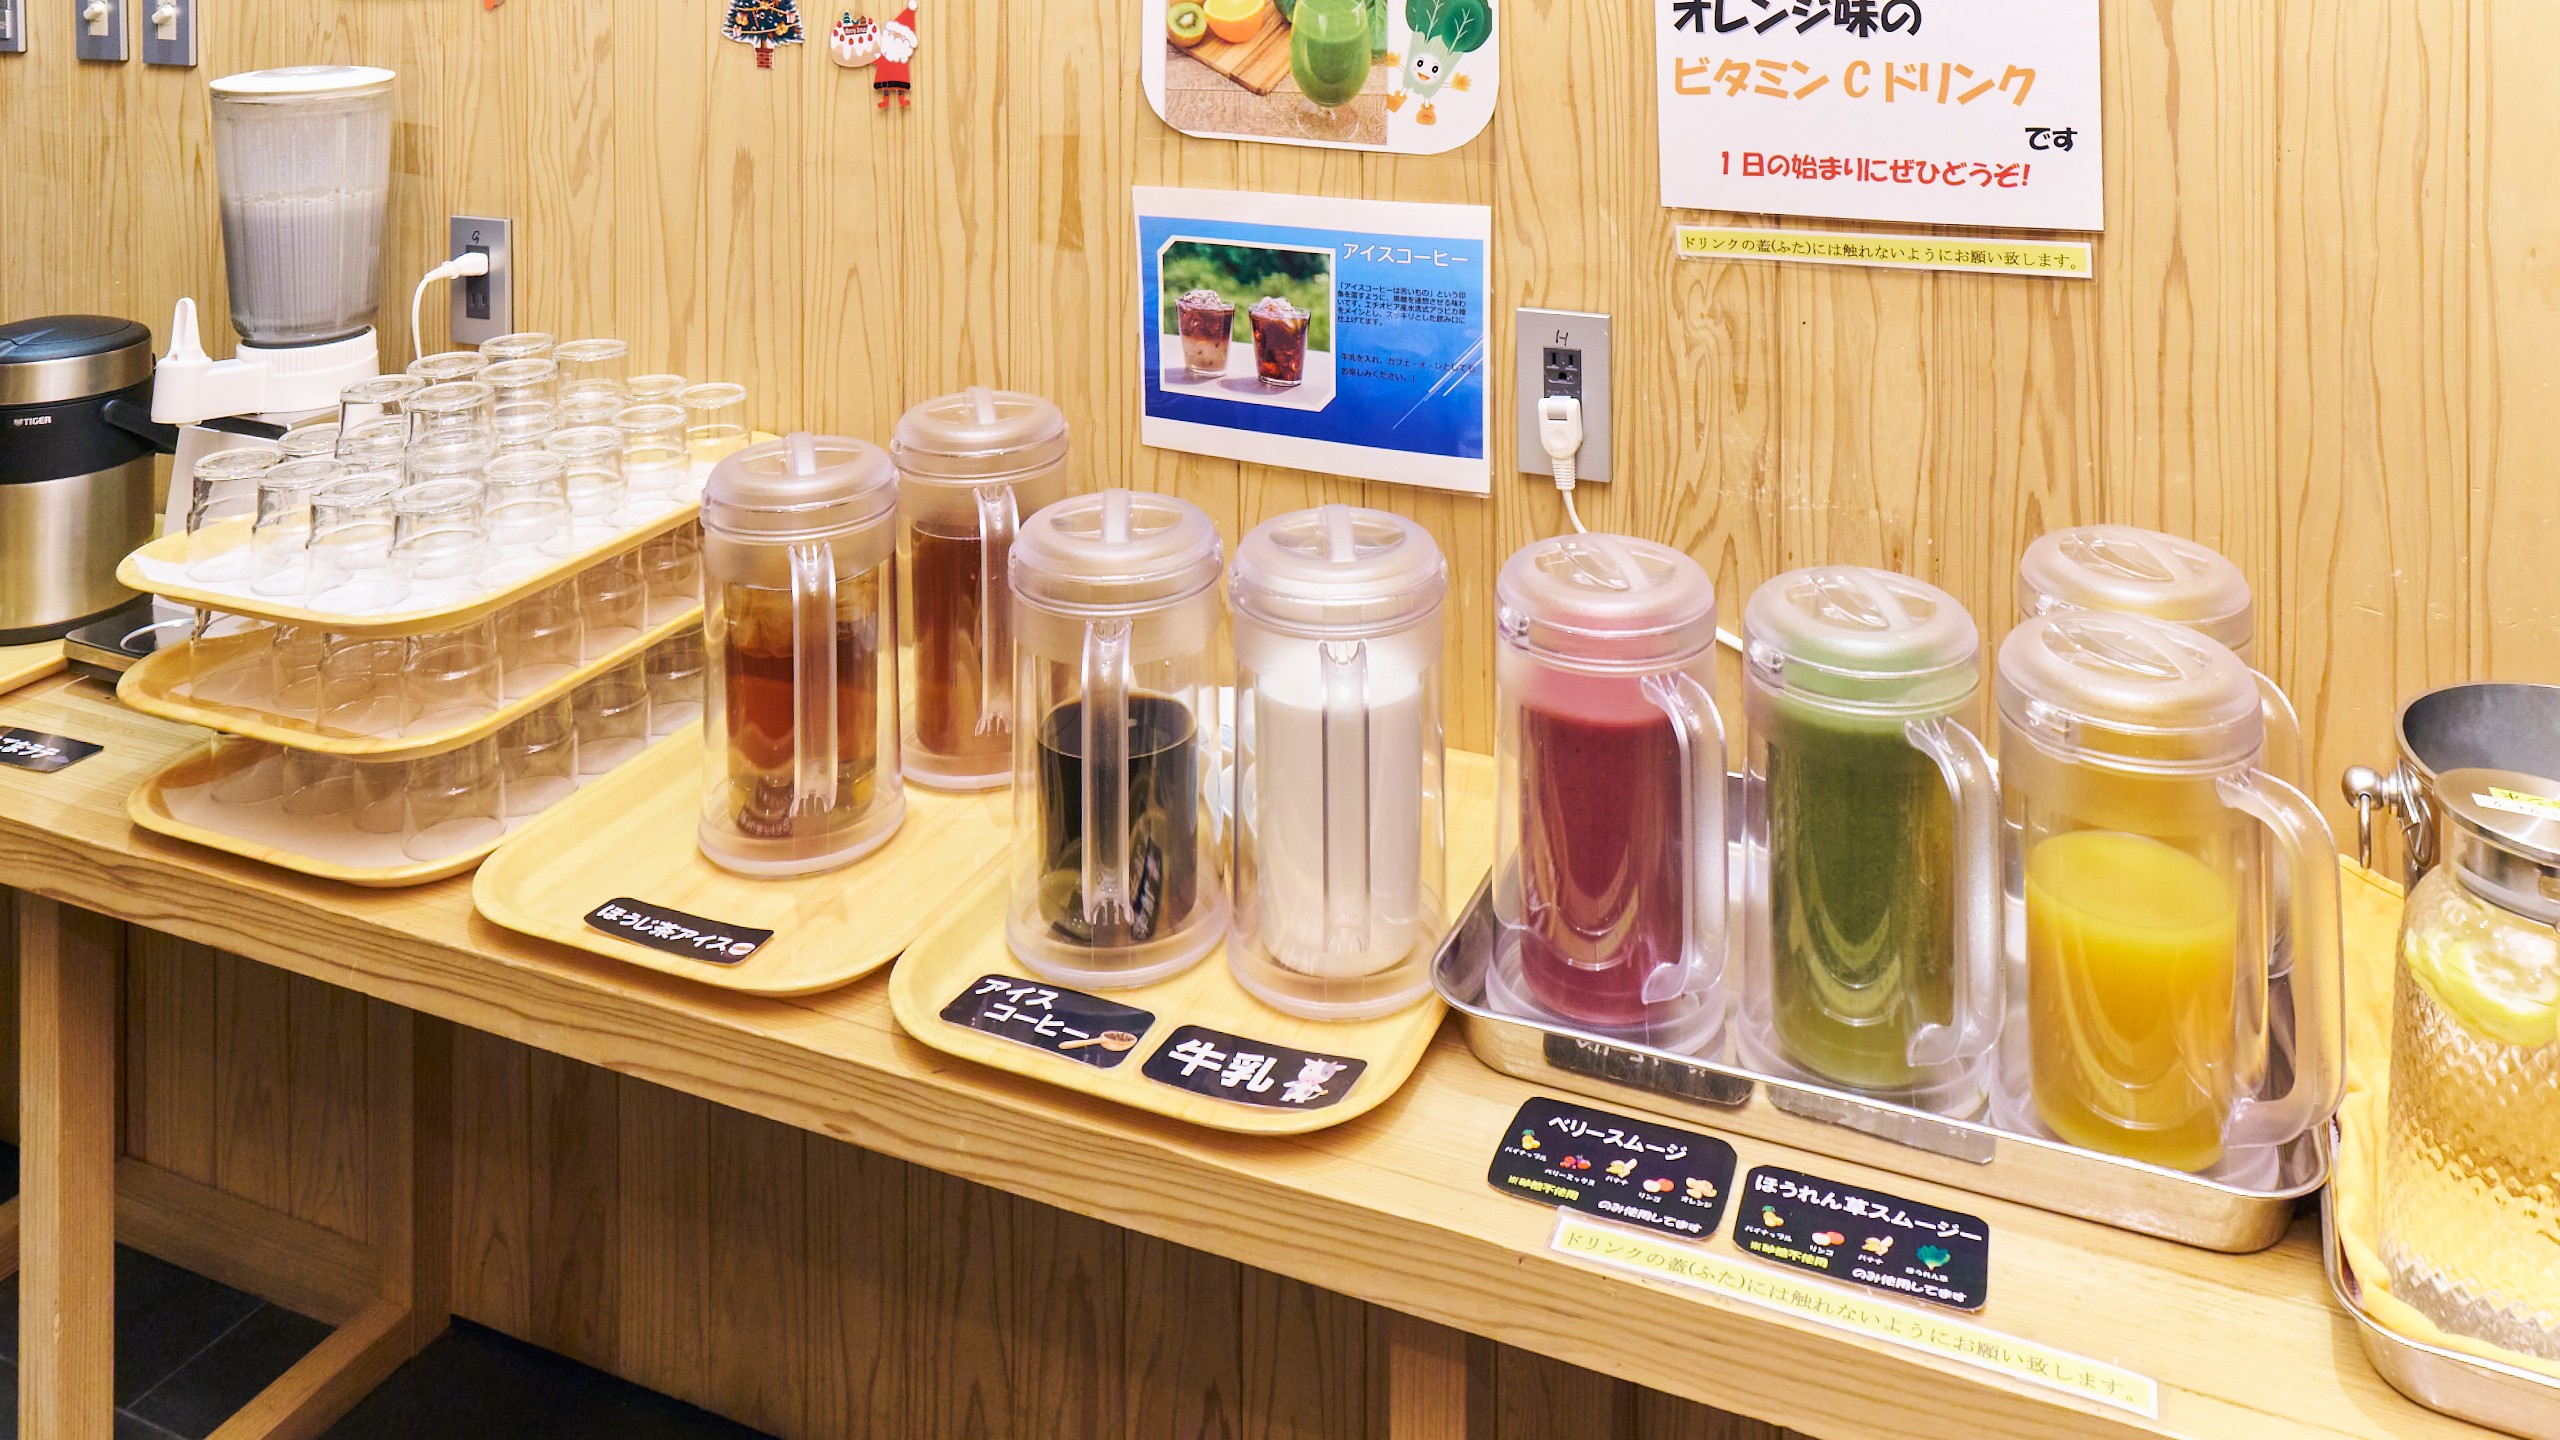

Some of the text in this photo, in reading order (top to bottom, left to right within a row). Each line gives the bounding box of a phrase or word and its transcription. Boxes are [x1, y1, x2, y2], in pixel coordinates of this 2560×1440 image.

[1673, 0, 1922, 38] オレンジ味の
[2025, 126, 2078, 152] です
[1343, 243, 1469, 267] アイスコーヒー
[1685, 236, 2076, 270] ドリンクの蓋(ふた)には触れないようにお願い致します。
[1555, 330, 1569, 346] H
[23, 415, 52, 426] TIGER
[596, 903, 734, 952] ほうじ茶アイス
[975, 979, 1060, 1010] アイス
[984, 1003, 1090, 1039] コーヒー
[1168, 1039, 1280, 1093] 牛乳
[1548, 1116, 1689, 1161] ベリースムージ
[1754, 1174, 1983, 1241] ほうれん草スムージー
[1566, 1231, 2133, 1402] ドリンクの蓋(ふた)には触れないようにお願い致します。
